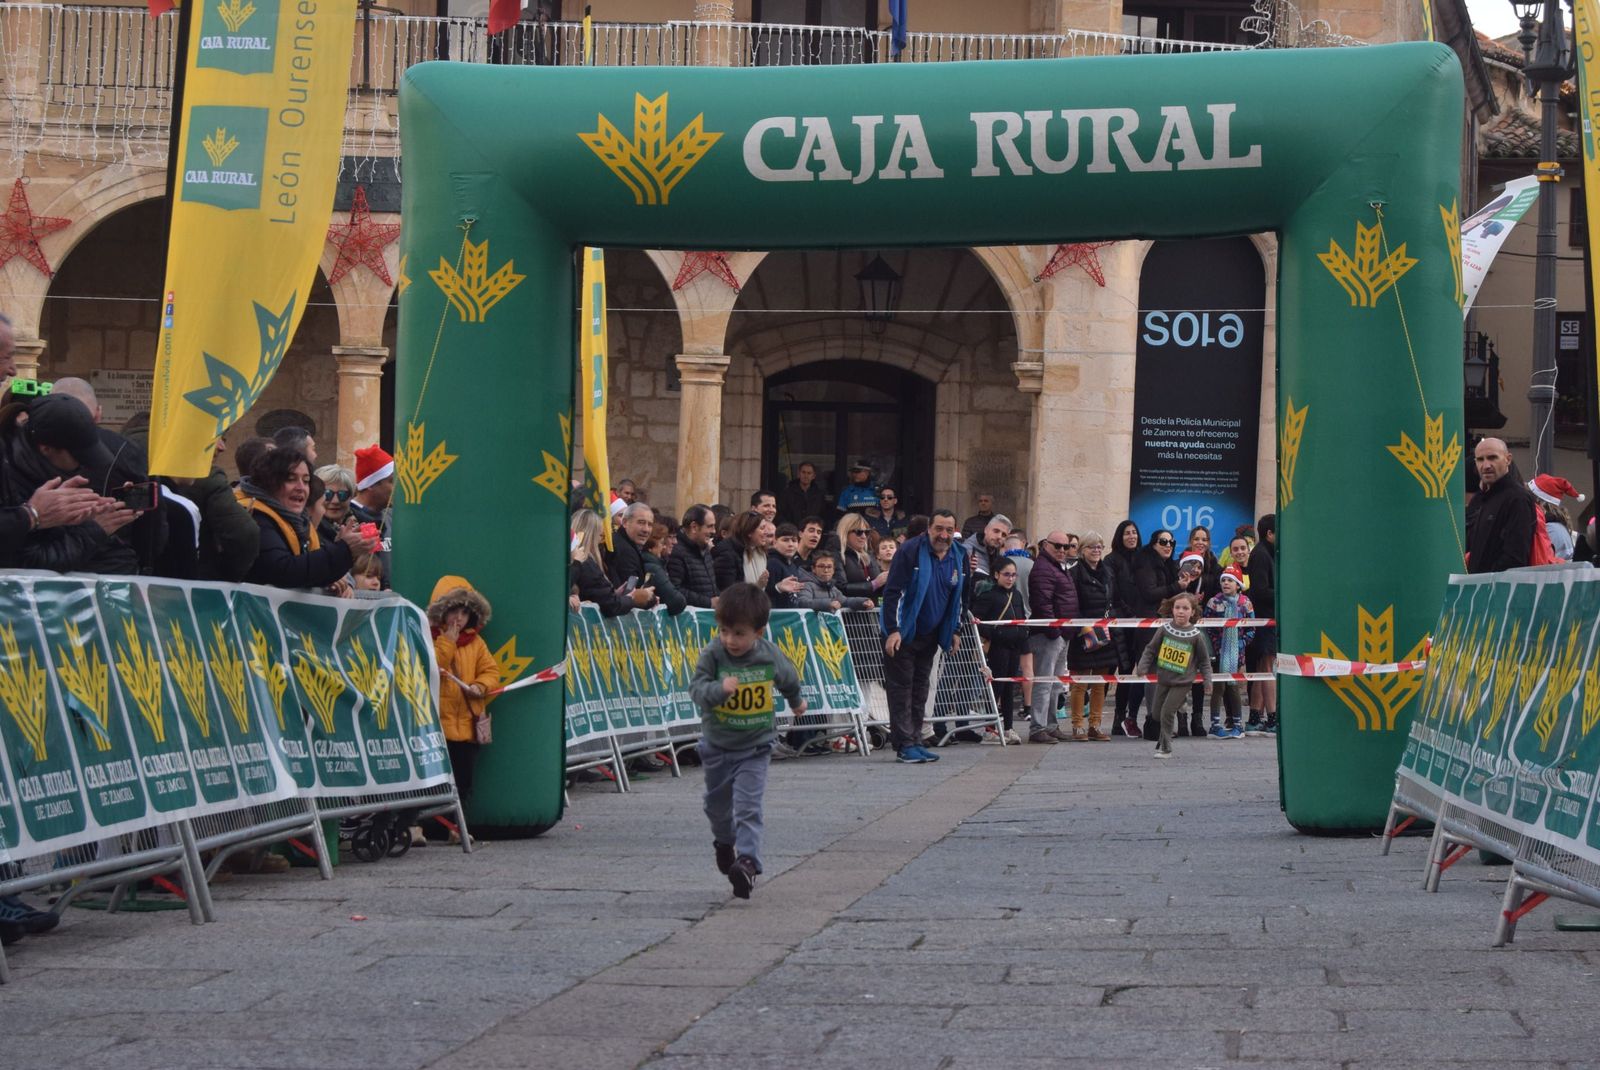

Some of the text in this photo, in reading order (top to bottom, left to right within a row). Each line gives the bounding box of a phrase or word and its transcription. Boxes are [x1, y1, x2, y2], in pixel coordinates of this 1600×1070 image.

[201, 36, 271, 50] CAJA RURAL
[742, 103, 1262, 185] CAJA RURAL
[185, 170, 257, 186] CAJA RURAL
[270, 151, 301, 224] León
[1562, 321, 1578, 333] SE
[1140, 416, 1241, 429] Desde la Policía Municipal
[1142, 428, 1239, 439] de Zamora te ofrecemos
[1145, 440, 1236, 450] nuestra ayuda cuando
[1157, 451, 1223, 461] más la necesitas
[1161, 504, 1215, 532] 016
[1162, 646, 1186, 664] 1305
[720, 685, 766, 711] 303
[84, 759, 138, 789] CAJA RURAL
[18, 775, 46, 802] CAJA
[42, 769, 78, 797] RURAL
[109, 786, 135, 805] ZAMORA
[45, 799, 74, 818] ZAMORA
